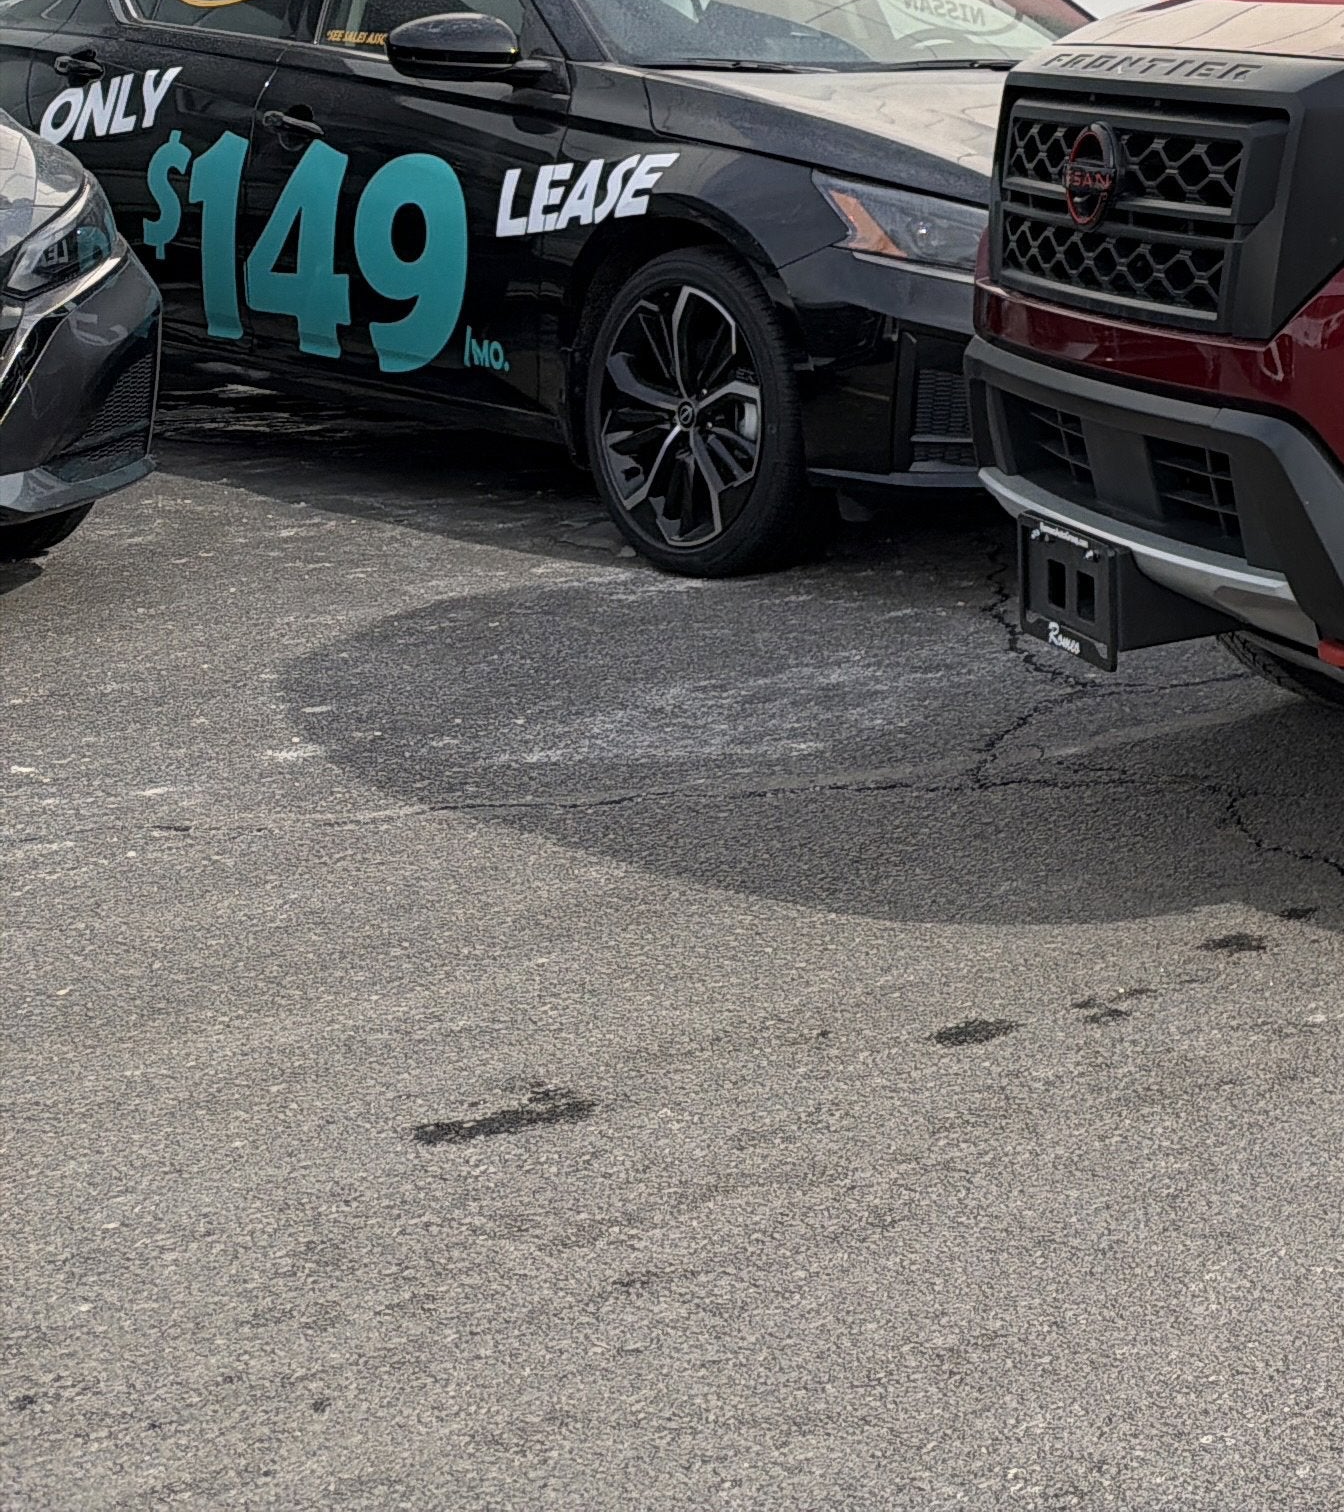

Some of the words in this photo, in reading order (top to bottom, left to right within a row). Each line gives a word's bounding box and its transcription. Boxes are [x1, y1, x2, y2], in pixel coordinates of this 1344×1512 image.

[40, 67, 182, 143] ONLY
[1041, 54, 1263, 80] FRONTIER
[496, 152, 680, 237] LEASE
[142, 130, 468, 373] $149
